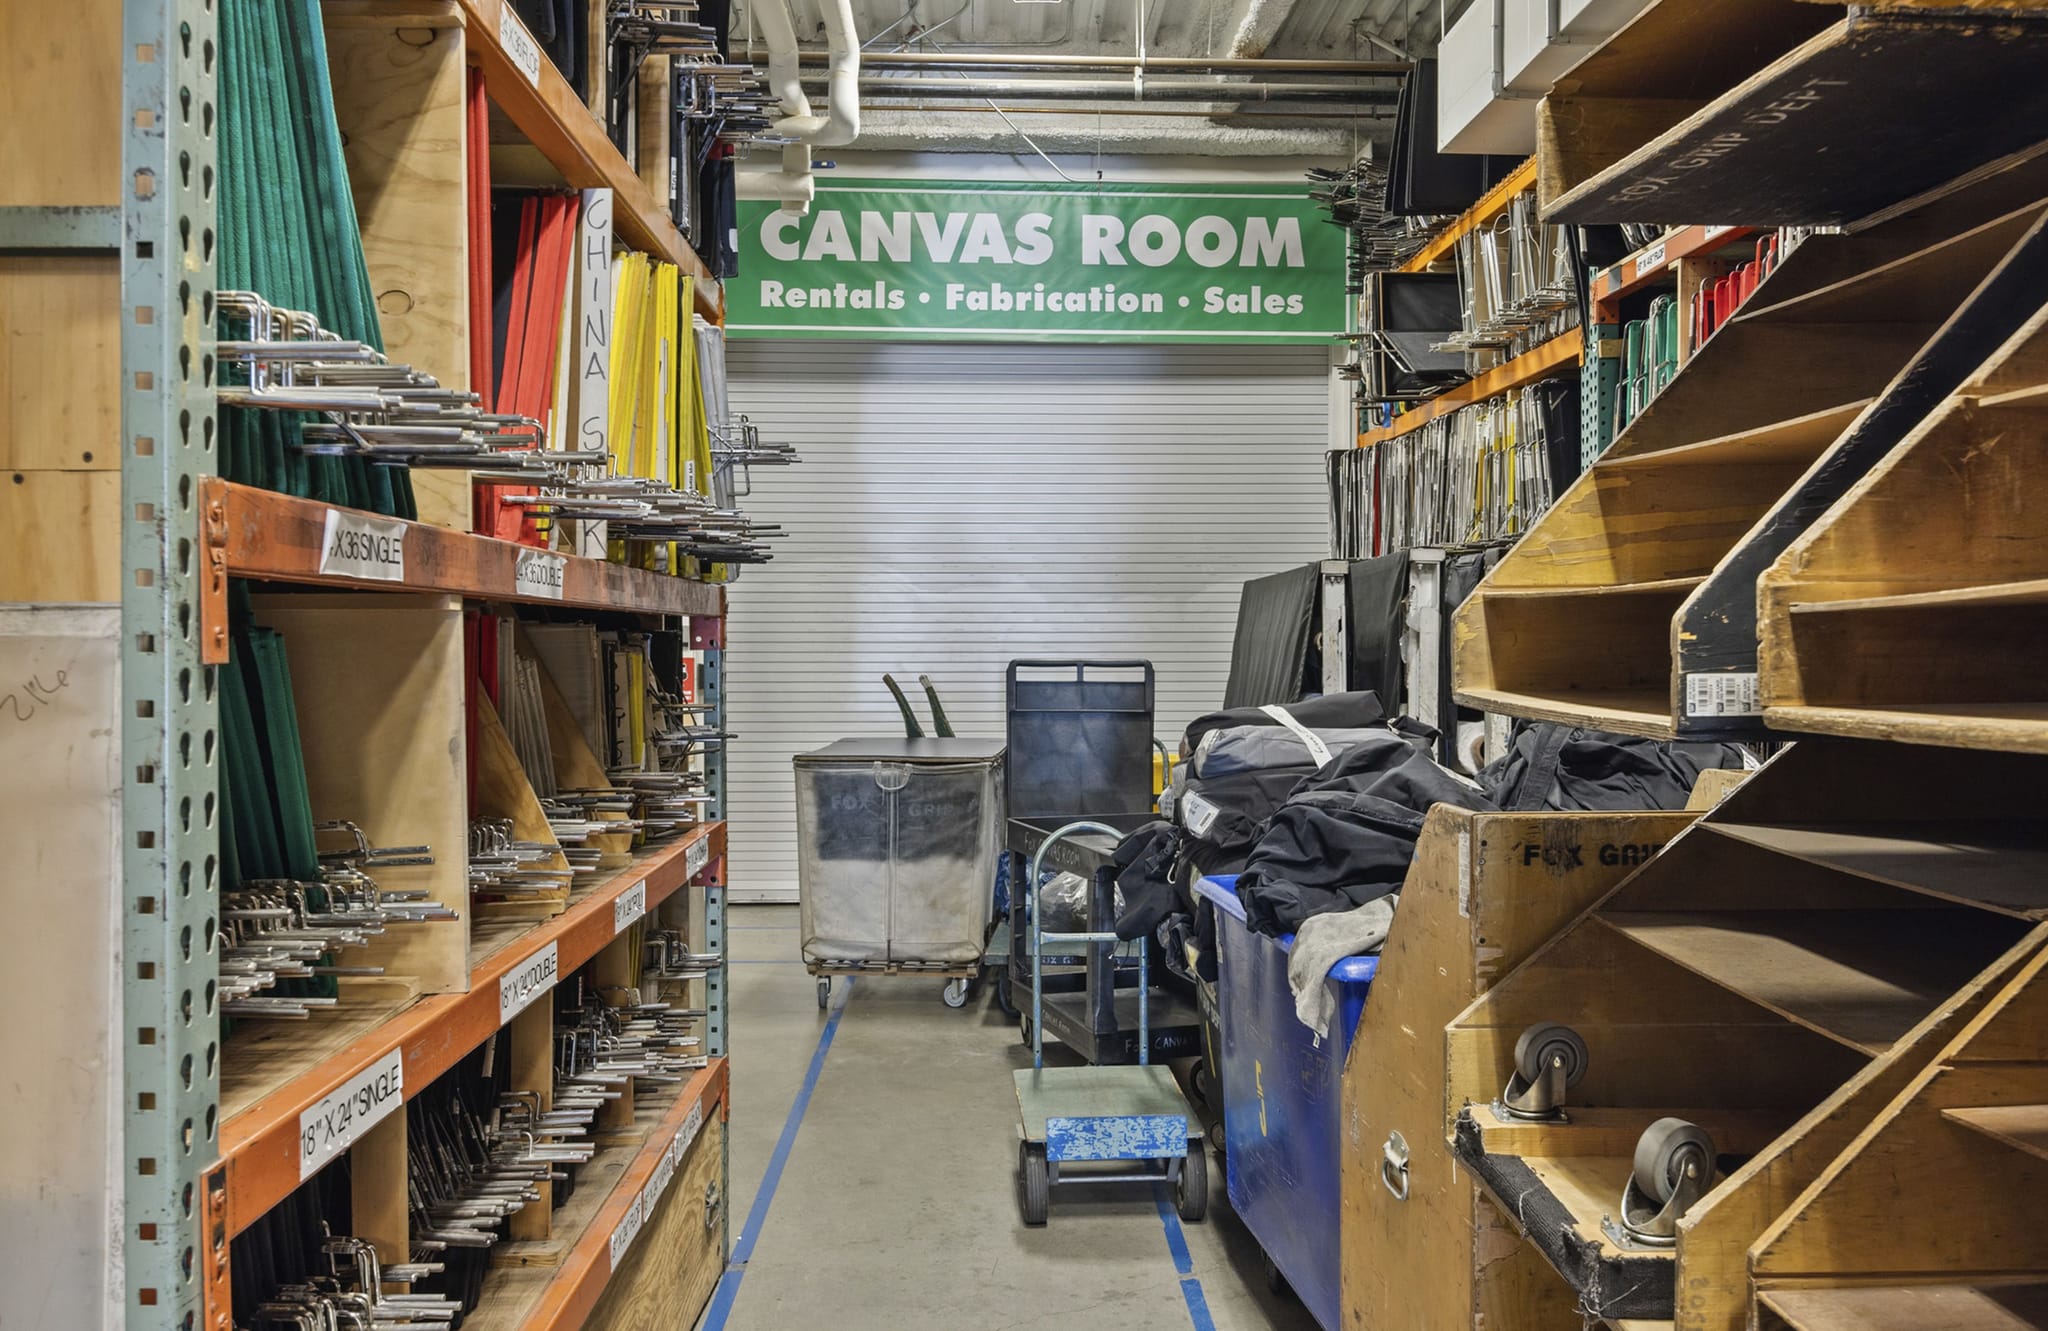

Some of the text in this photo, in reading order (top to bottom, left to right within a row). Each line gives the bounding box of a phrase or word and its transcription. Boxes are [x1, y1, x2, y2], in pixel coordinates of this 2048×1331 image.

[760, 209, 1305, 268] CANVAS ROOM
[586, 199, 607, 381] CHINA
[760, 280, 1304, 315] Rentals Fabrication Sales
[1523, 843, 1584, 867] FOX
[325, 1108, 336, 1144] X
